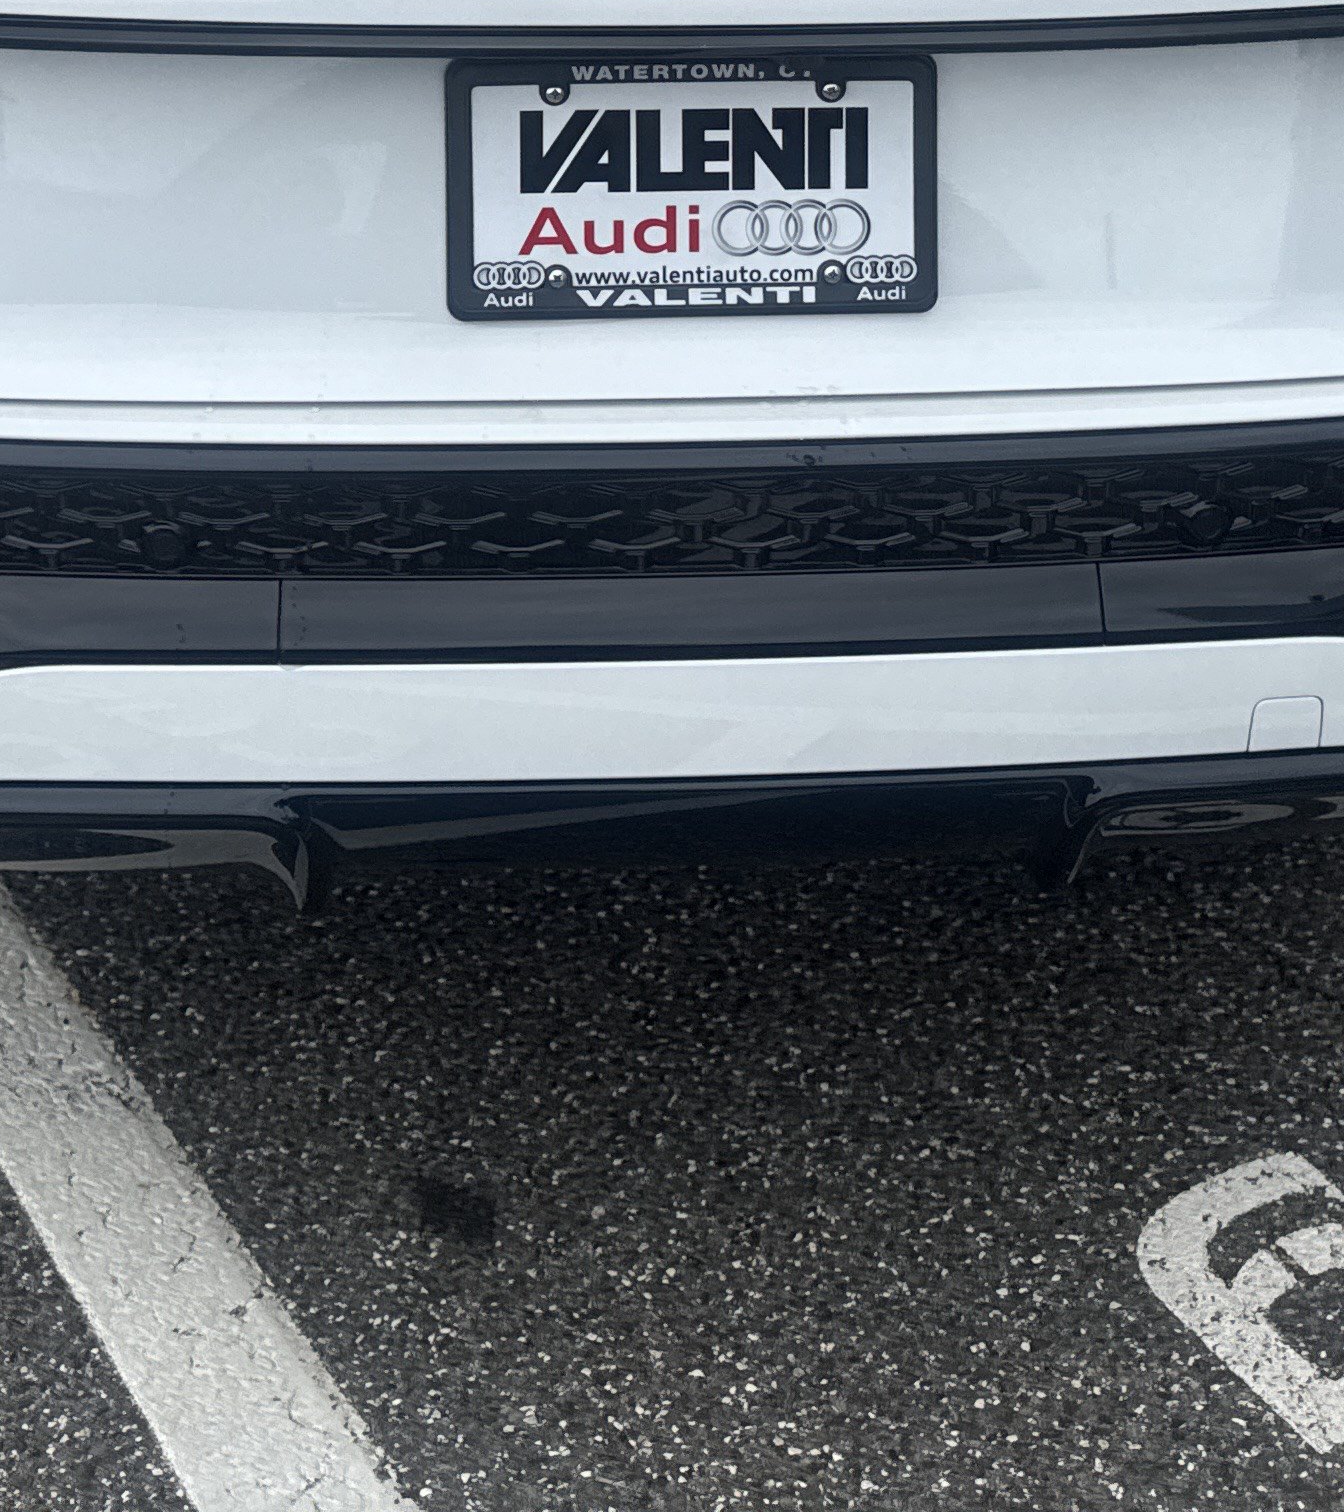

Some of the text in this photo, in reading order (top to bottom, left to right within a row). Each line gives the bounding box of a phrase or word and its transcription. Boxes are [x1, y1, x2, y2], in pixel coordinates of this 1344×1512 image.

[571, 63, 764, 81] WATERTOWN,
[519, 106, 869, 194] VALENTI
[518, 205, 700, 255] Audi
[575, 265, 814, 285] www.valentiauto.com
[483, 292, 534, 307] Audi
[575, 286, 816, 307] VALENTI
[857, 286, 907, 301] Audi
